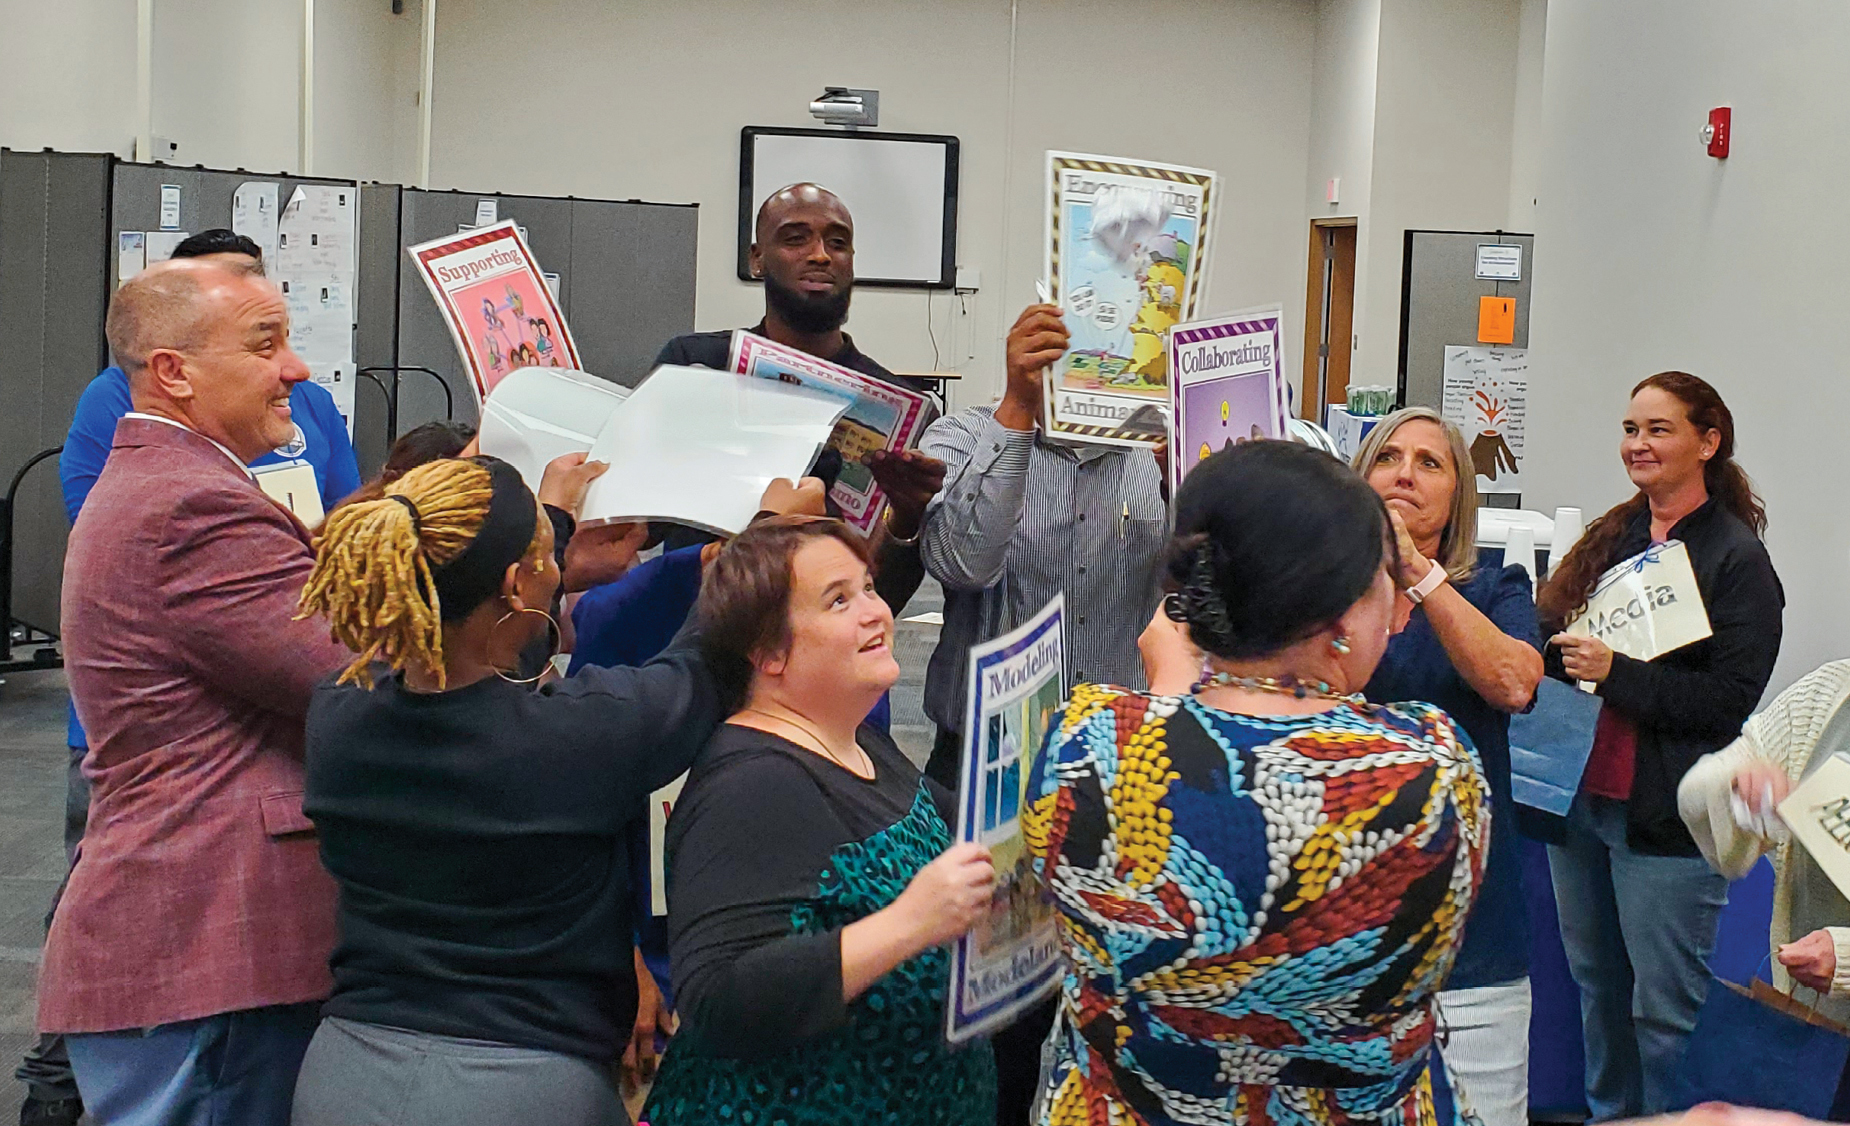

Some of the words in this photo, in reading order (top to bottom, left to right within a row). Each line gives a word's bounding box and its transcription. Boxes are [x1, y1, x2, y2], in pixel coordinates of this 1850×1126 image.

[438, 248, 523, 284] Supporting
[758, 347, 904, 407] Partnering
[1181, 340, 1272, 375] Collaborating
[1060, 396, 1136, 420] Anima
[1588, 585, 1677, 640] Media
[989, 638, 1059, 698] Modeling
